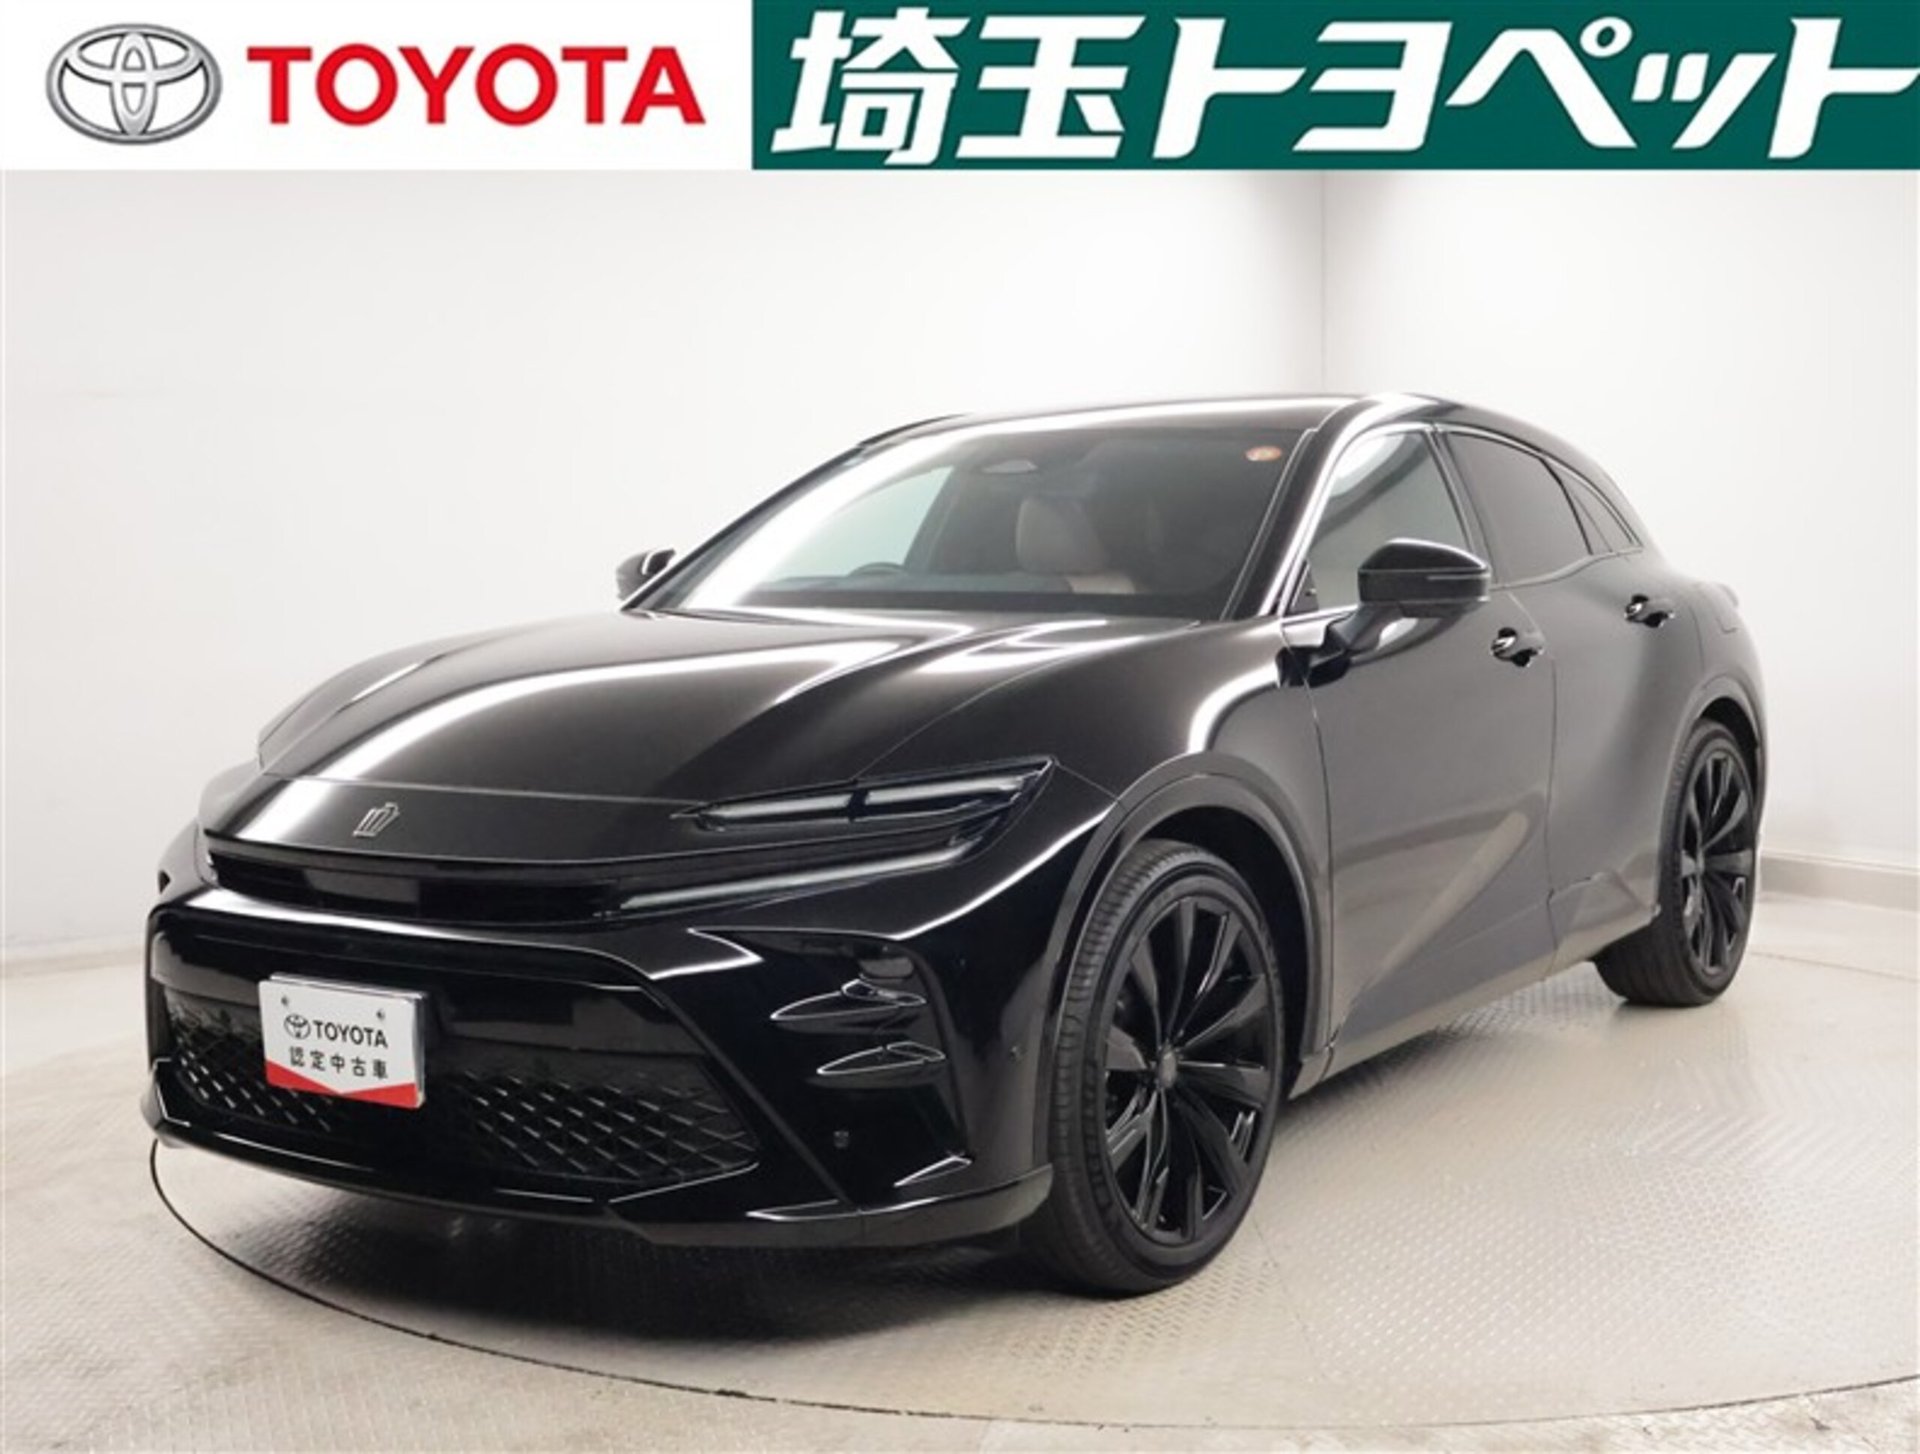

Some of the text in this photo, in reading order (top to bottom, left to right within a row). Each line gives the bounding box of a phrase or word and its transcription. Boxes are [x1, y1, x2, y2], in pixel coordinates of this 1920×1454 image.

[313, 1020, 388, 1048] TOYOTA
[289, 1046, 388, 1079] 認定中古車
